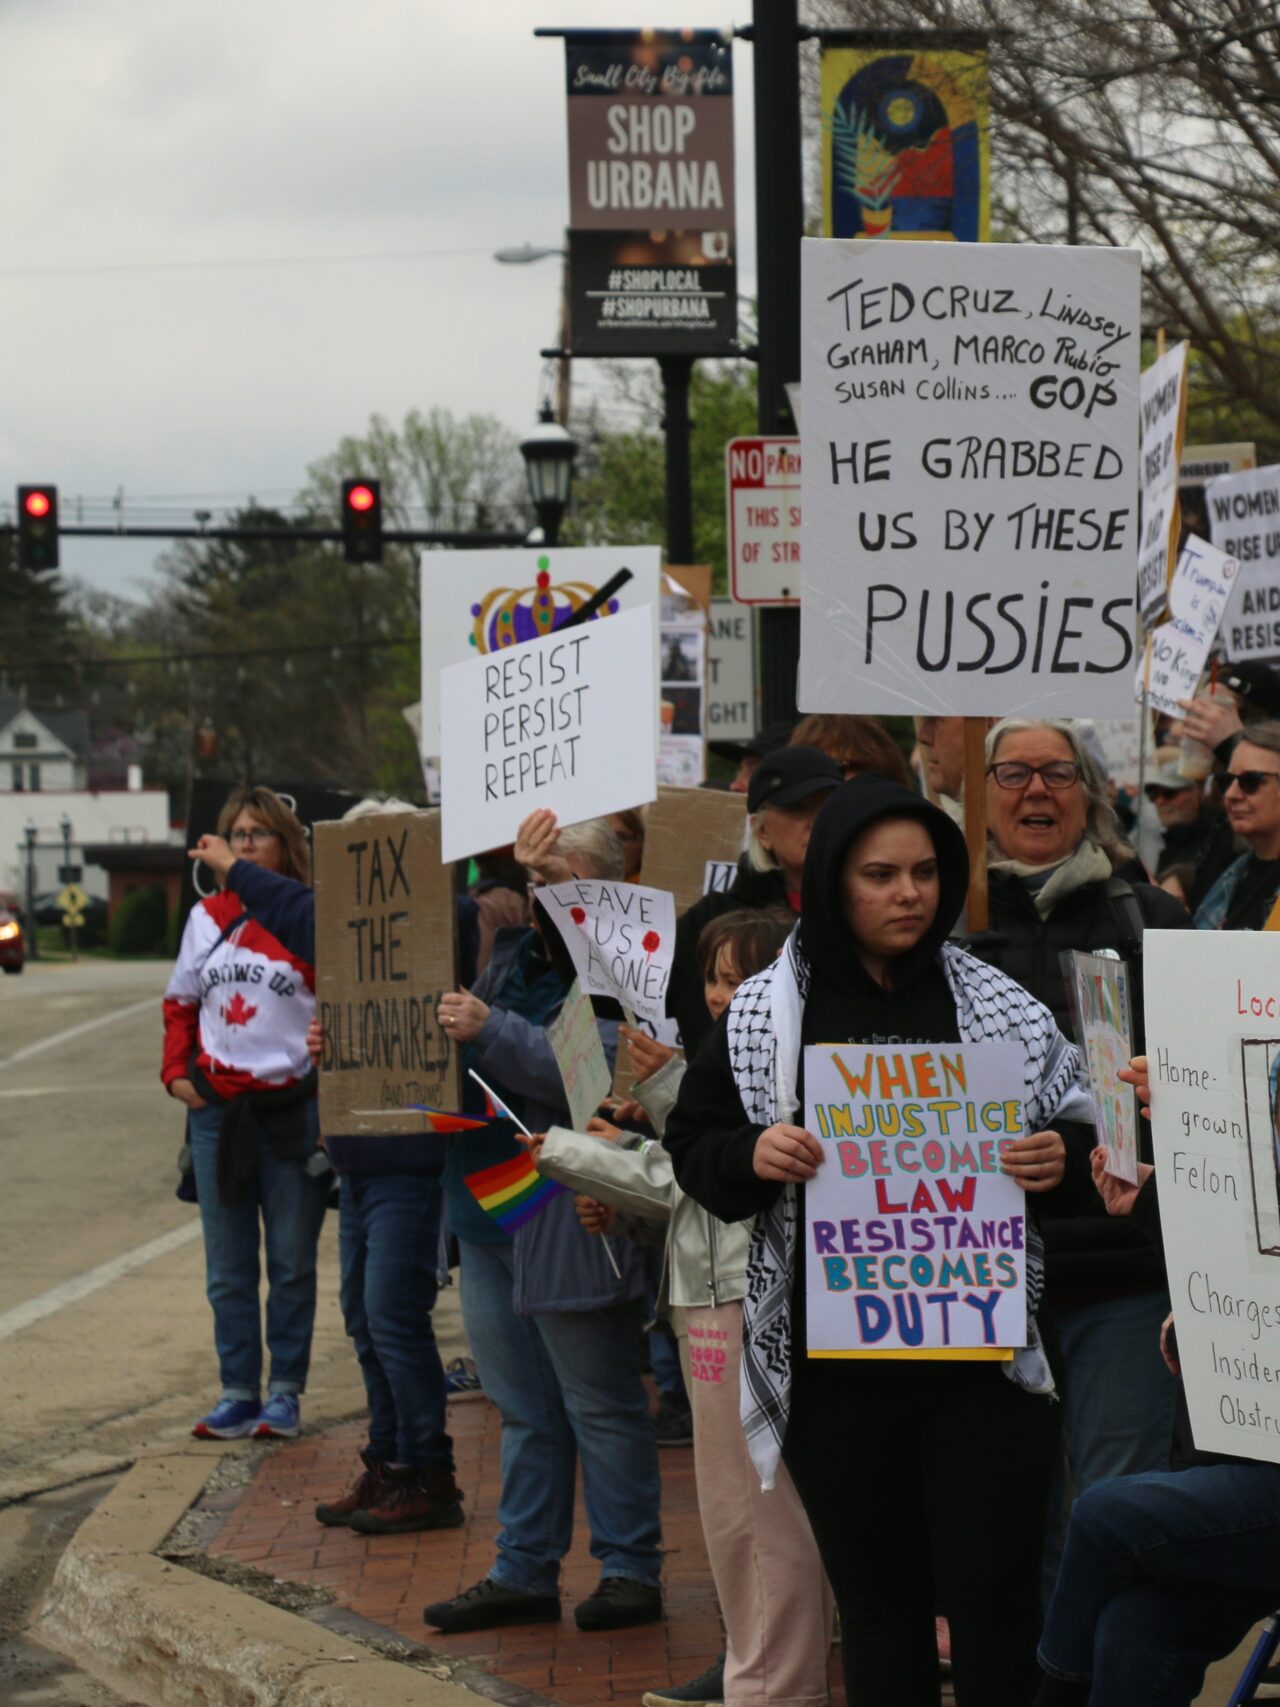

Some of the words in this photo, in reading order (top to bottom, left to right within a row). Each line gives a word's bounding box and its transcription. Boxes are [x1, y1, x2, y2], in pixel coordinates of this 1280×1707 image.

[607, 104, 696, 154] SHOP
[587, 160, 724, 210] URBANA
[608, 269, 702, 292] #SHOPLOCAL
[601, 297, 710, 320] #SHOPURBANA
[827, 278, 915, 332] TED
[953, 334, 1046, 365] MARCO
[1052, 336, 1121, 377] Rubio
[835, 378, 906, 404] SUSAN
[1029, 374, 1119, 419] GOP
[730, 448, 763, 481] NO
[829, 439, 892, 485] HE
[921, 435, 1124, 480] GRABBED
[745, 506, 780, 528] THIS
[1213, 487, 1280, 522] WOMEN
[858, 511, 918, 552] US
[944, 508, 995, 552] BY
[1007, 502, 1130, 552] THESE
[742, 541, 762, 563] OF
[772, 541, 801, 563] STR
[1225, 535, 1261, 562] RISE
[706, 617, 745, 641] ANE
[484, 634, 590, 704] RESIST
[484, 684, 590, 753] PERSIST
[707, 701, 749, 725] GHT
[484, 734, 581, 803] REPEAT
[347, 828, 411, 907] TAX
[549, 882, 653, 925] LEAVE
[347, 910, 409, 983] THE
[593, 916, 634, 956] US
[267, 971, 296, 998] UP
[586, 941, 670, 1000] AONE!
[830, 1051, 969, 1100] WHEN
[813, 1099, 1024, 1139] INJUSTICE
[1181, 1110, 1244, 1140] grown
[874, 1175, 978, 1215] LAW
[1172, 1150, 1239, 1202] Felon
[812, 1215, 1026, 1255] RESISTANCE
[821, 1251, 1019, 1293] BECOMES
[853, 1289, 1004, 1348] DUTY
